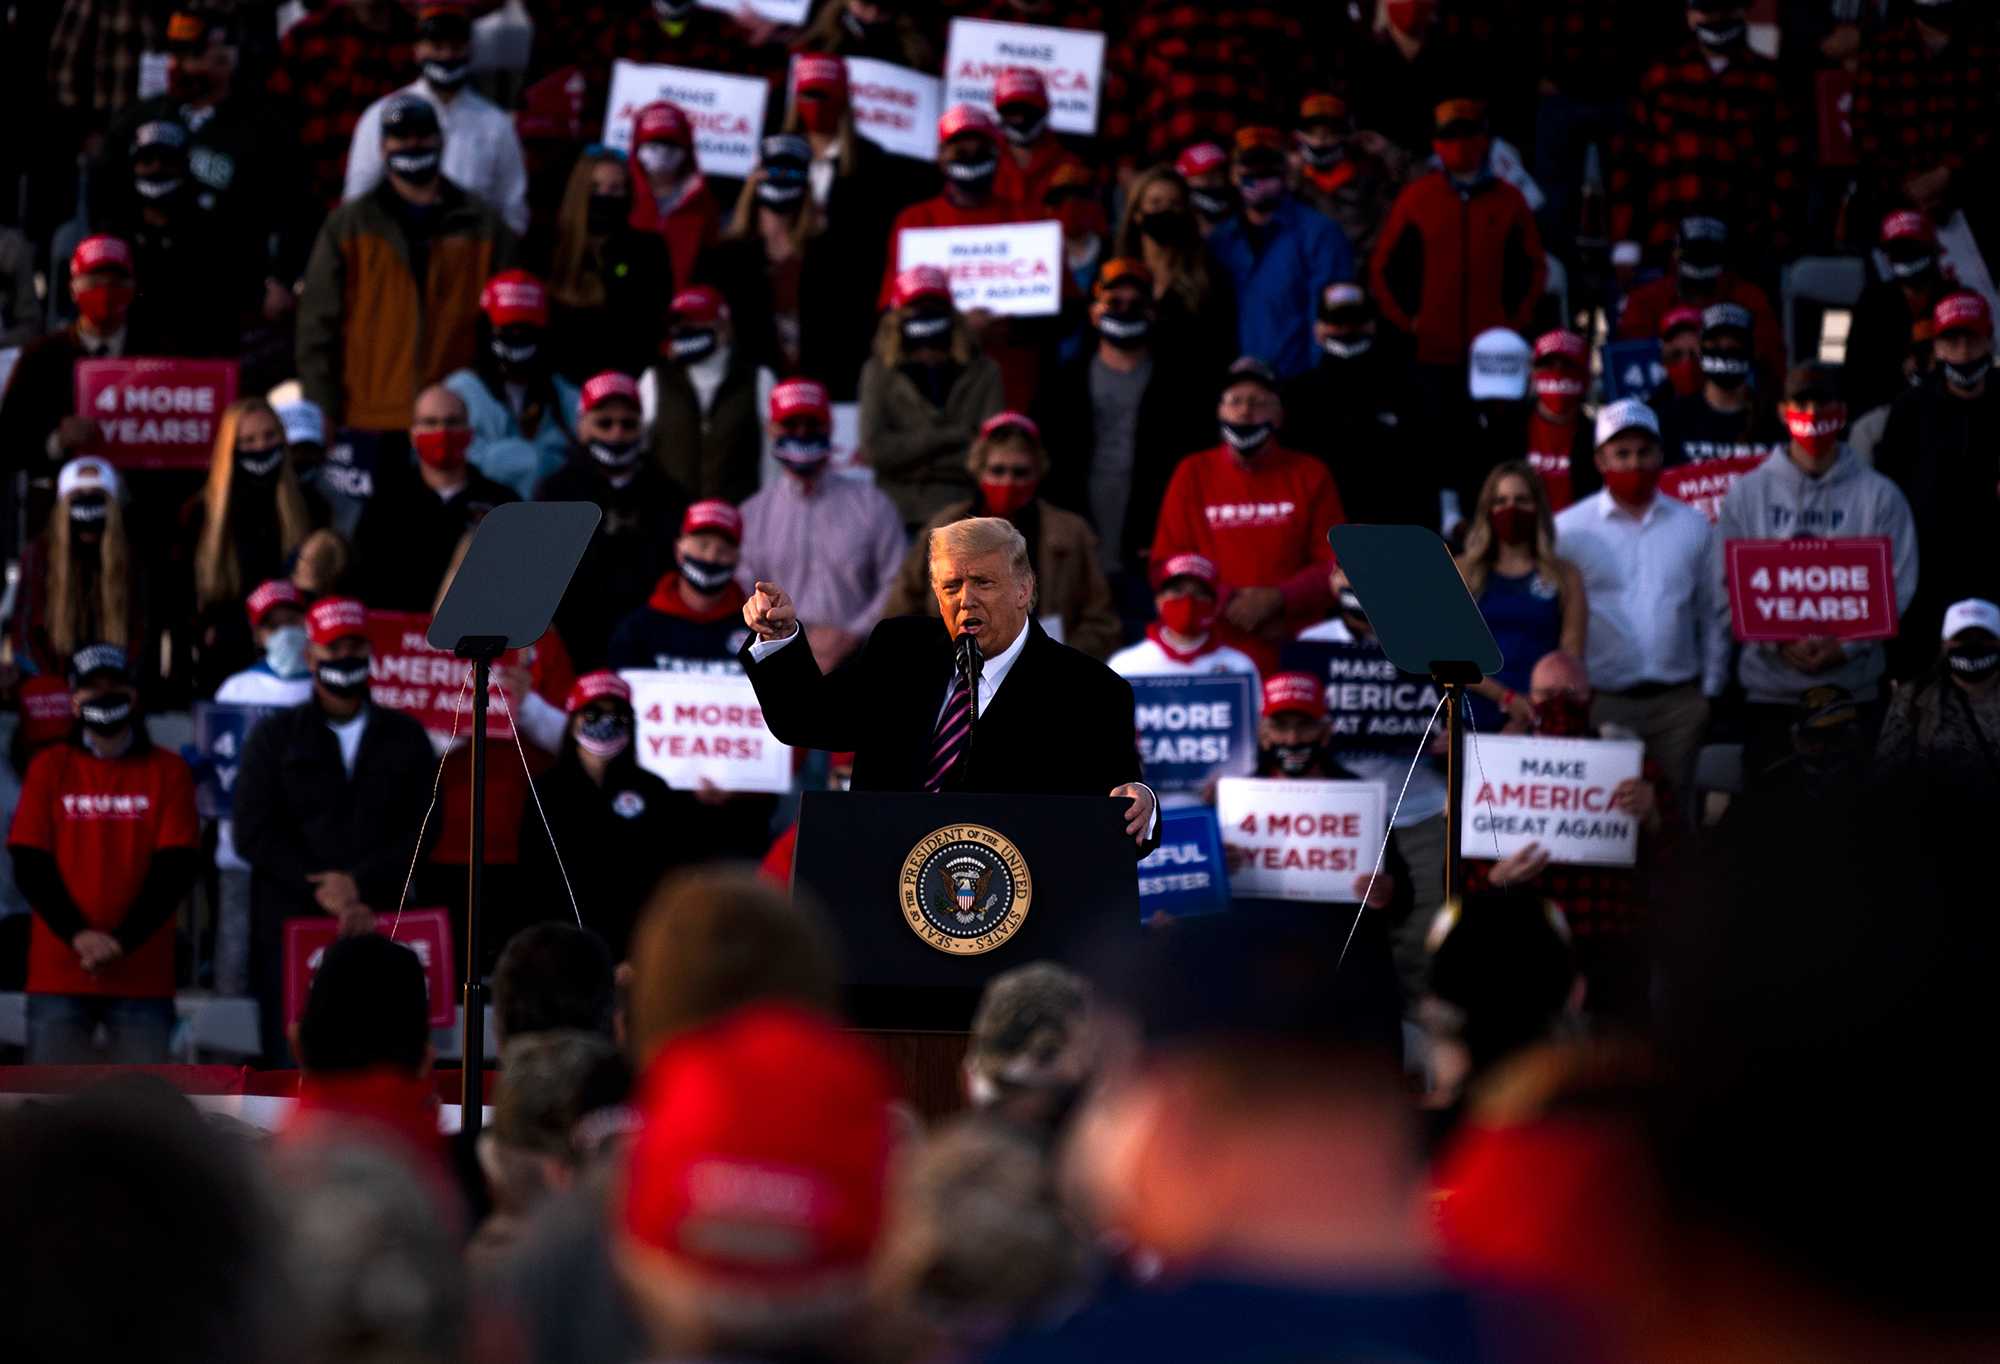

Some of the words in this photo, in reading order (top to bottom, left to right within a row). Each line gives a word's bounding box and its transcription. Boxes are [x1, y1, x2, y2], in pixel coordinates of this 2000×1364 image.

[94, 384, 118, 414] 4
[123, 384, 216, 414] MORE
[99, 416, 211, 445] YEARS!
[1204, 501, 1296, 523] TRUMP
[1750, 565, 1771, 592] 4
[1777, 565, 1869, 592] MORE
[1755, 596, 1870, 622] YEARS!
[1329, 657, 1398, 680] MAKE
[1324, 683, 1441, 712] ERICA
[645, 703, 662, 723] 4
[674, 704, 765, 728] MORE
[1134, 702, 1232, 732] MORE
[1367, 713, 1445, 736] AGAIN
[648, 734, 763, 760] YEARS!
[1140, 734, 1229, 765] EARS!
[1520, 758, 1588, 779] MAKE
[62, 794, 150, 815] TRUMP
[967, 830, 980, 839] OF
[1239, 814, 1257, 836] 4
[1267, 814, 1361, 838] MORE
[1473, 814, 1548, 834] GREAT
[1556, 818, 1630, 840] AGAIN
[982, 832, 999, 847] THE
[904, 828, 964, 885] PRESIDENT
[1247, 847, 1358, 871] YEARS!
[1000, 845, 1027, 899] UNITED
[1138, 872, 1211, 897] ESTER
[905, 889, 915, 908] THE
[909, 908, 921, 922] OF
[919, 920, 953, 949] SEAL
[976, 911, 1021, 949] STATES
